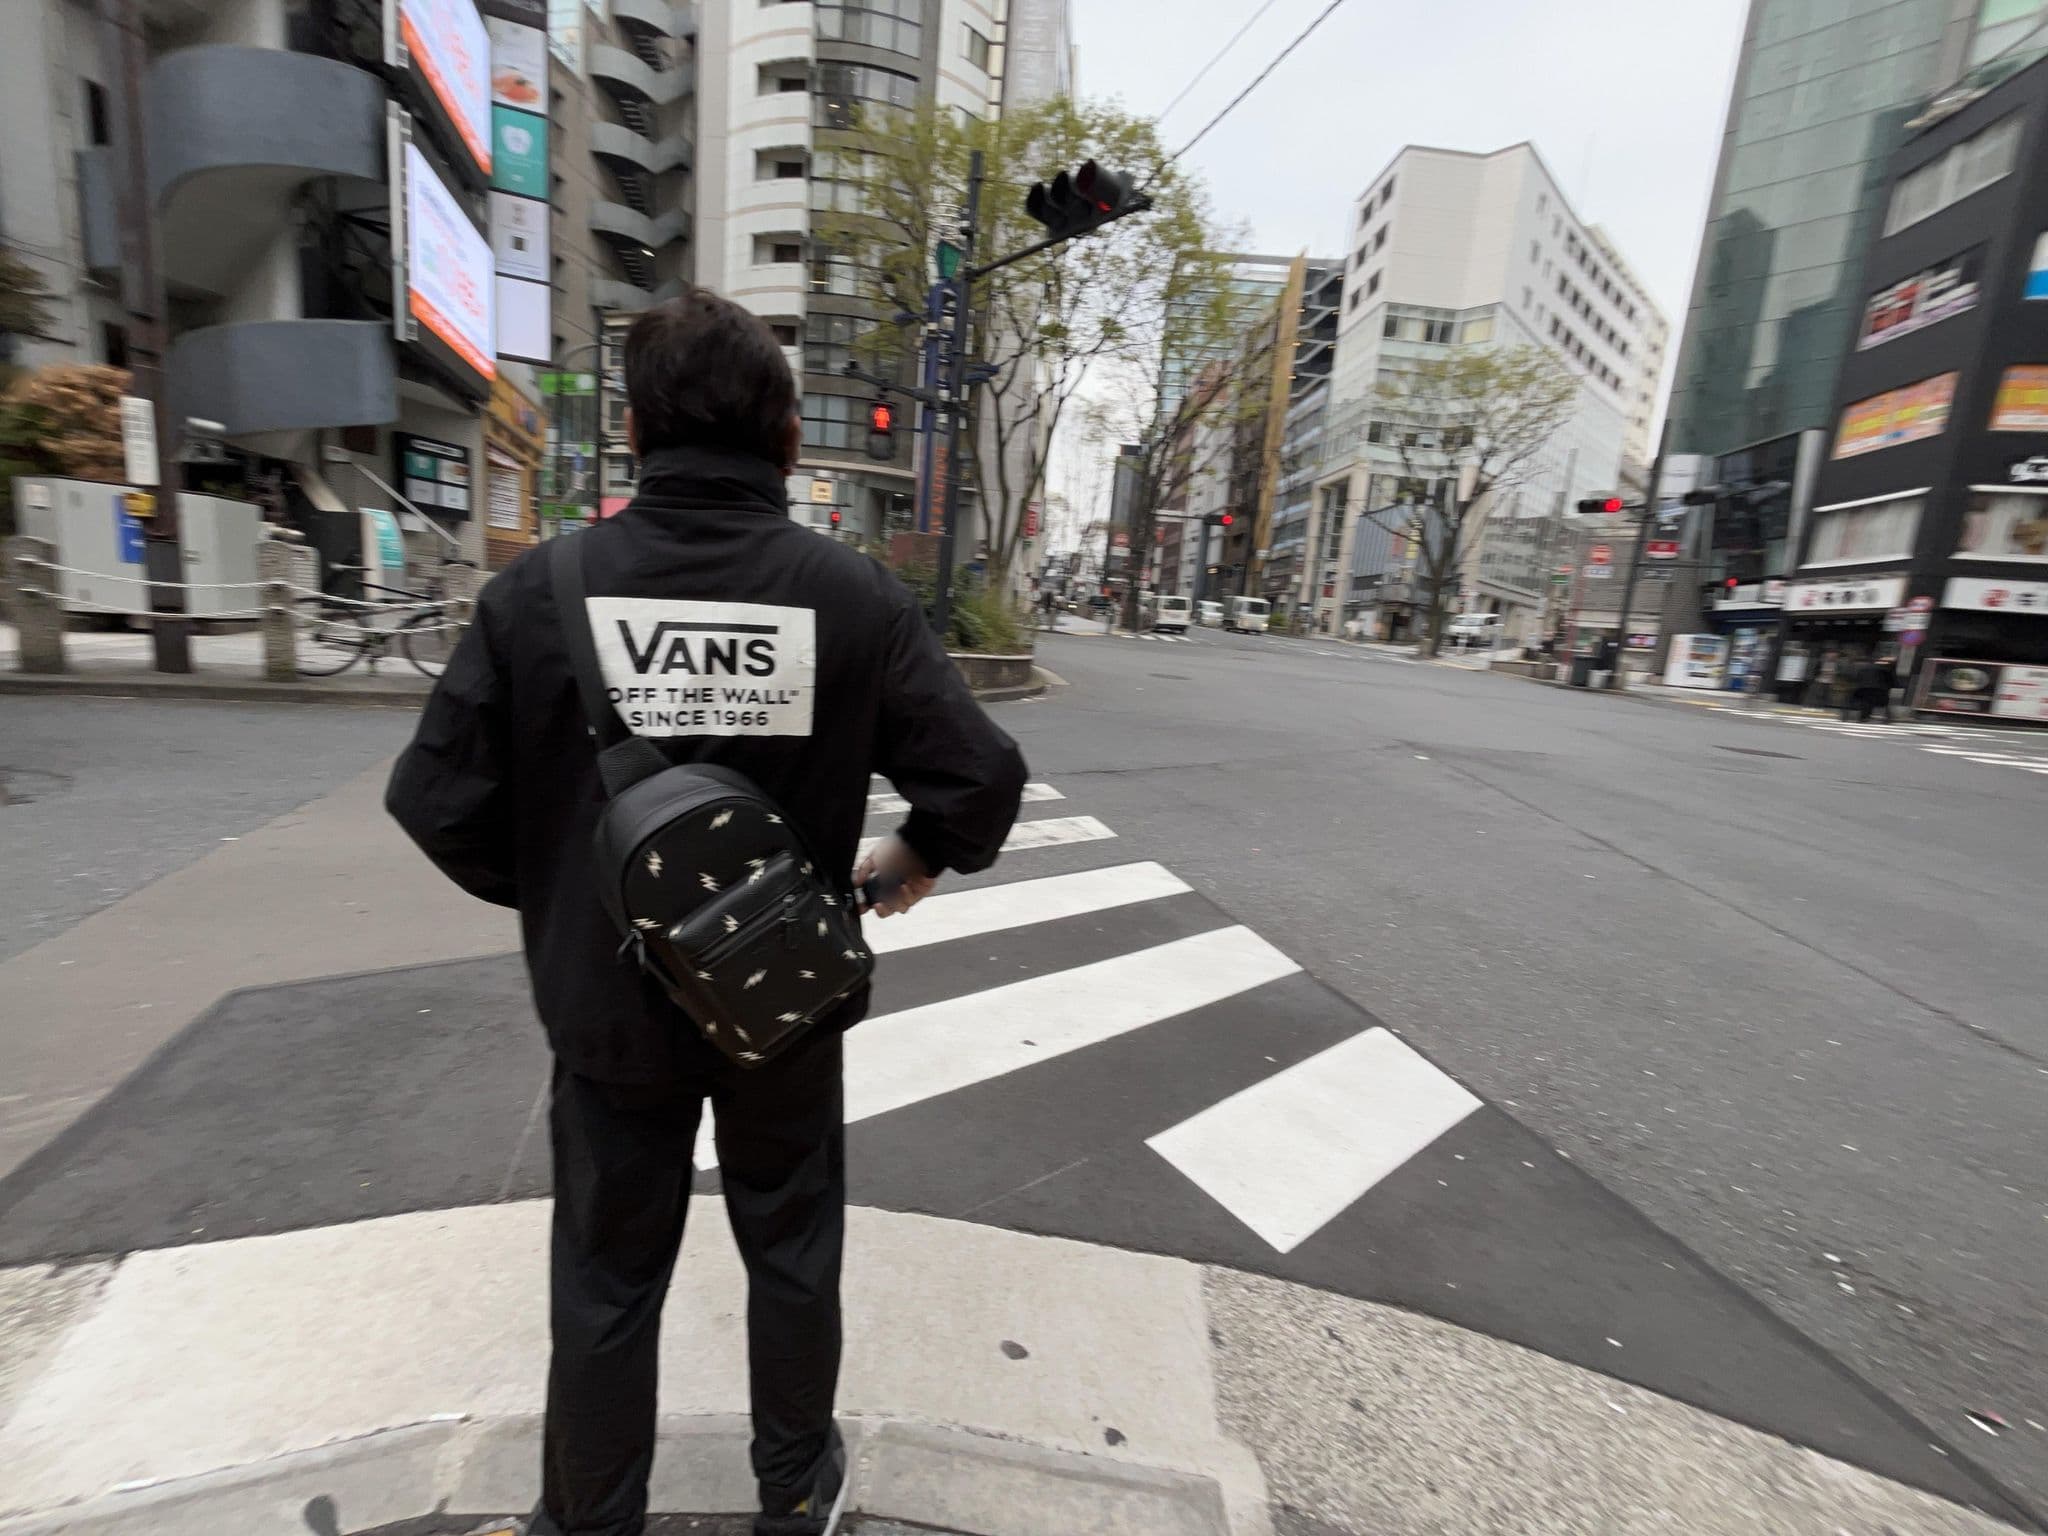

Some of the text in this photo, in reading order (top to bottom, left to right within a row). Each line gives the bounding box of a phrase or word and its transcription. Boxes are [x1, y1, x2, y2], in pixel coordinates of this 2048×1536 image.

[616, 619, 779, 678] VANS
[665, 687, 714, 704] THE
[630, 710, 769, 727] SINCE 1966
